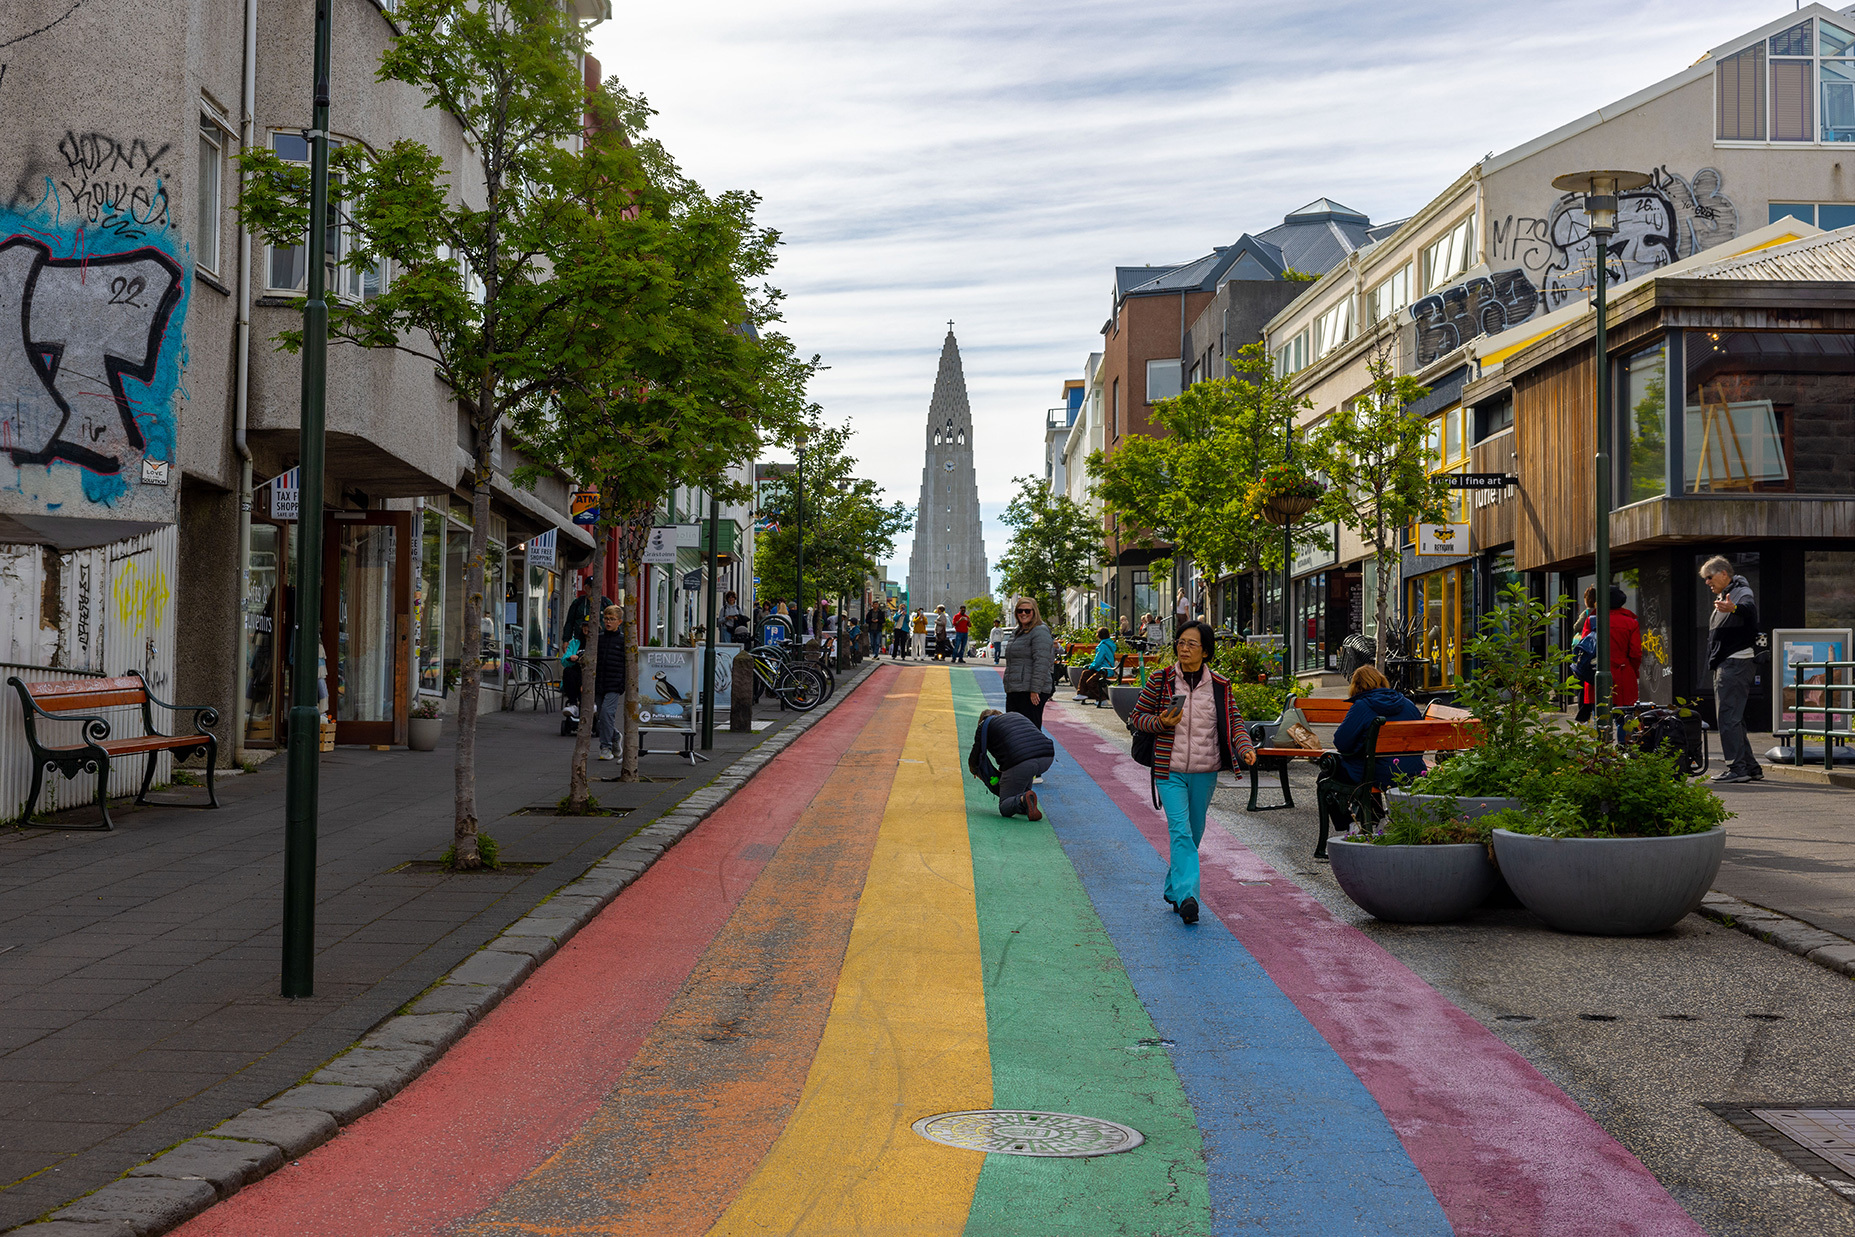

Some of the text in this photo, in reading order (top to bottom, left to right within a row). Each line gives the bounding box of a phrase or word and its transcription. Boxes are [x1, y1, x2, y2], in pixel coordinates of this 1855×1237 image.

[1465, 476, 1485, 486] fine
[1487, 477, 1502, 486] art
[277, 491, 291, 501] TAX
[576, 495, 598, 504] ATM
[277, 502, 299, 511] SHOPP
[531, 547, 553, 556] TAX FREE
[530, 554, 553, 562] SHOPPING
[647, 653, 686, 665] FENJA
